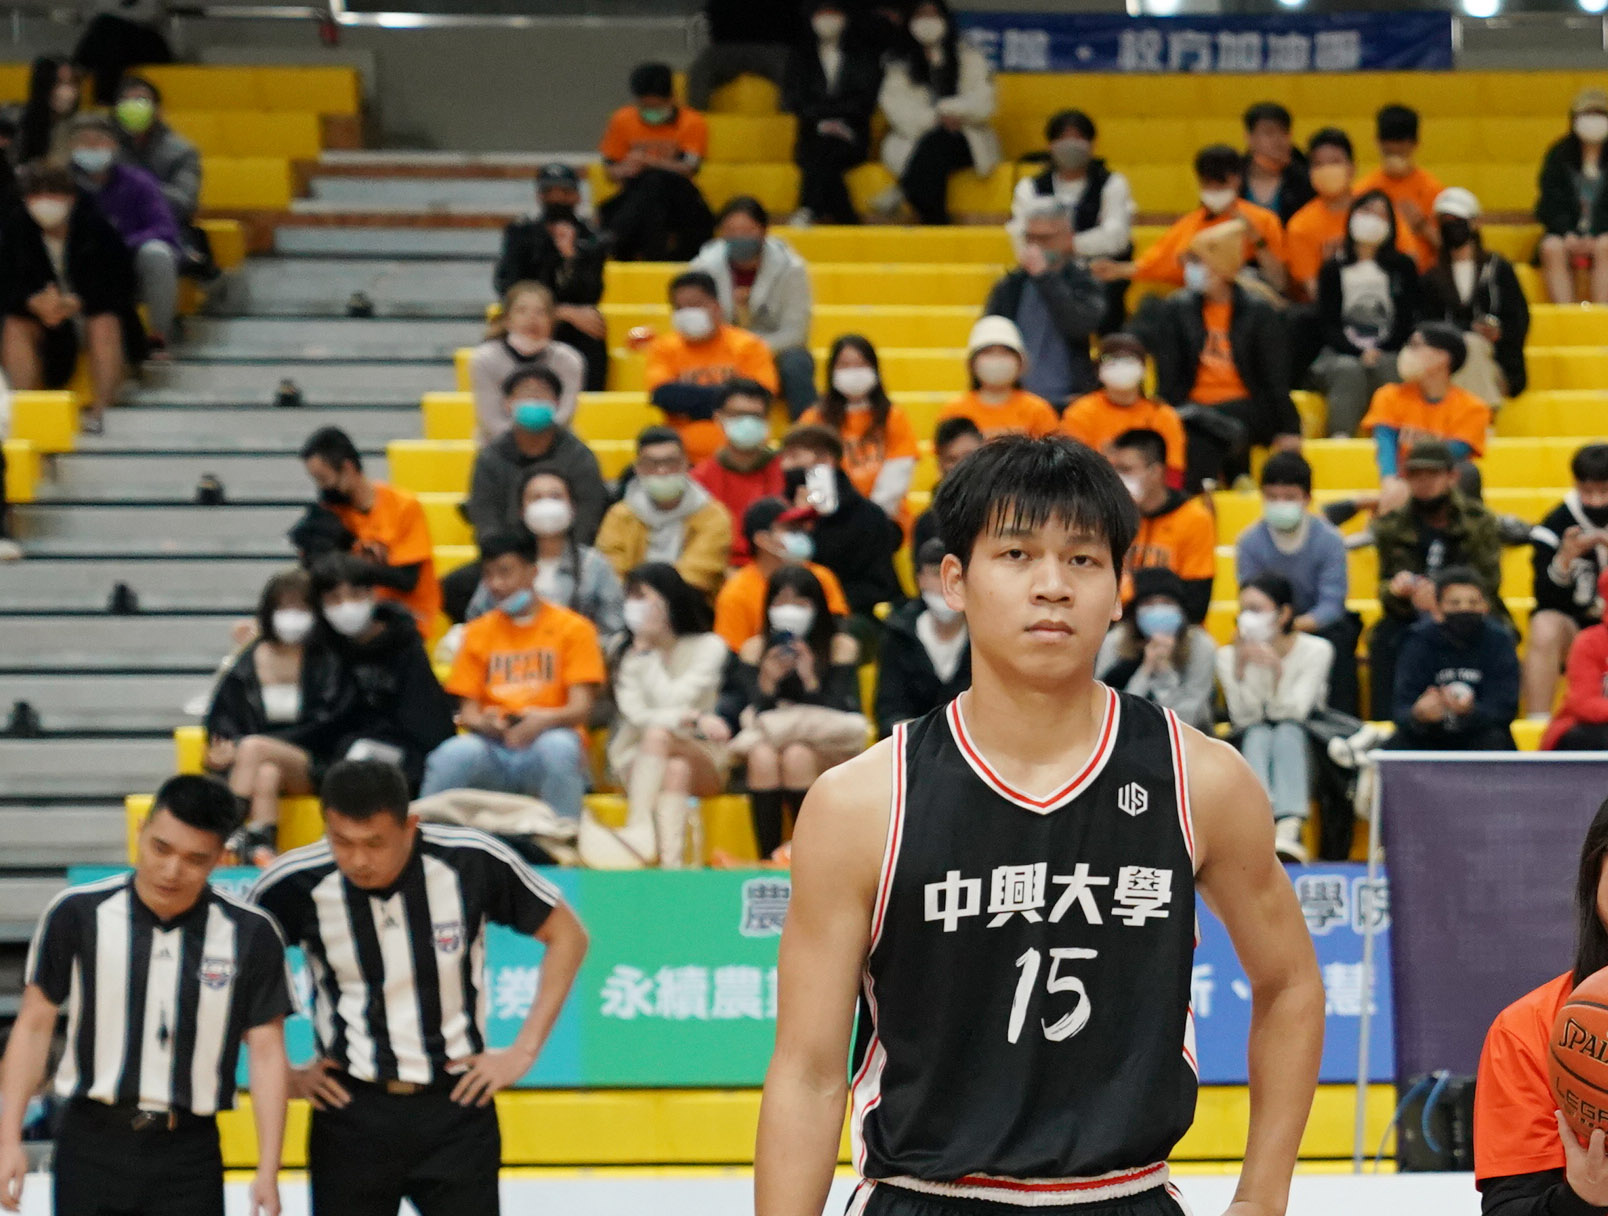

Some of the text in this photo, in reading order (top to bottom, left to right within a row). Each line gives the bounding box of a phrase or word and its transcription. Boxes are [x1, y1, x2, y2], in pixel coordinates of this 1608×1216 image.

[924, 862, 1173, 932] 中興大學
[600, 963, 778, 1019] 永續農
[1007, 946, 1099, 1045] 15
